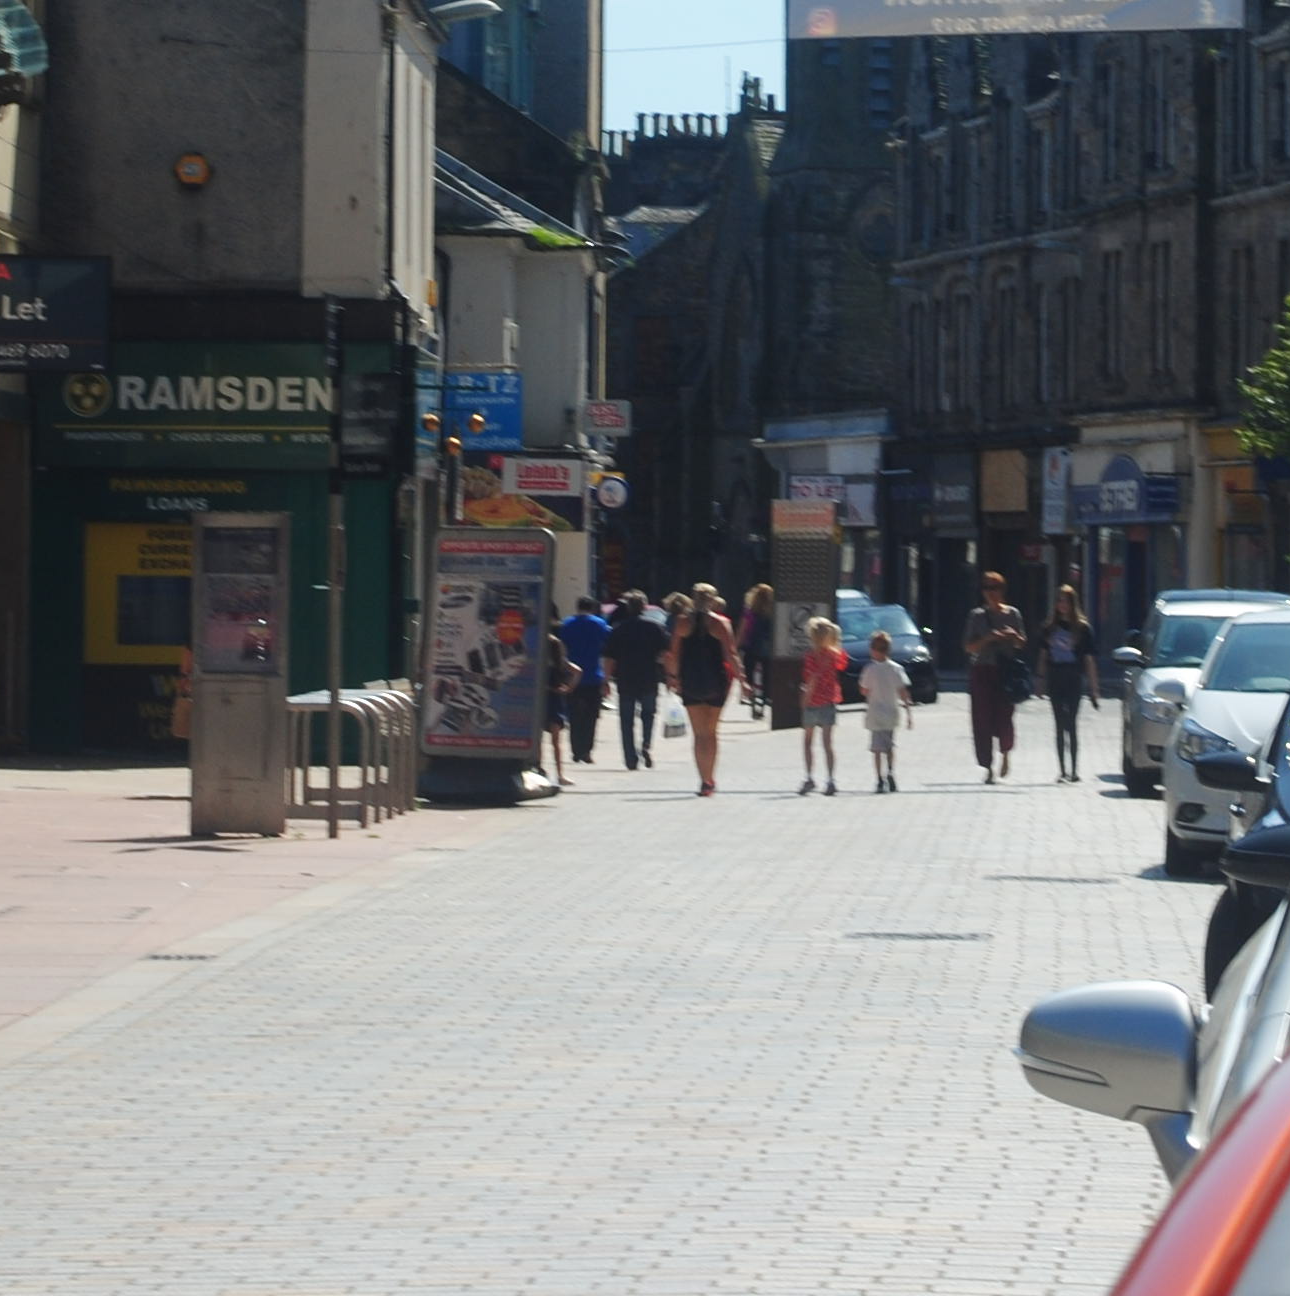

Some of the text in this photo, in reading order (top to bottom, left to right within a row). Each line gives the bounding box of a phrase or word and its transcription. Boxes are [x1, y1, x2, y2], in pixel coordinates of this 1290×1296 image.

[2, 294, 49, 321] Let
[117, 376, 334, 411] RAMSDEN
[145, 496, 209, 512] LOANS
